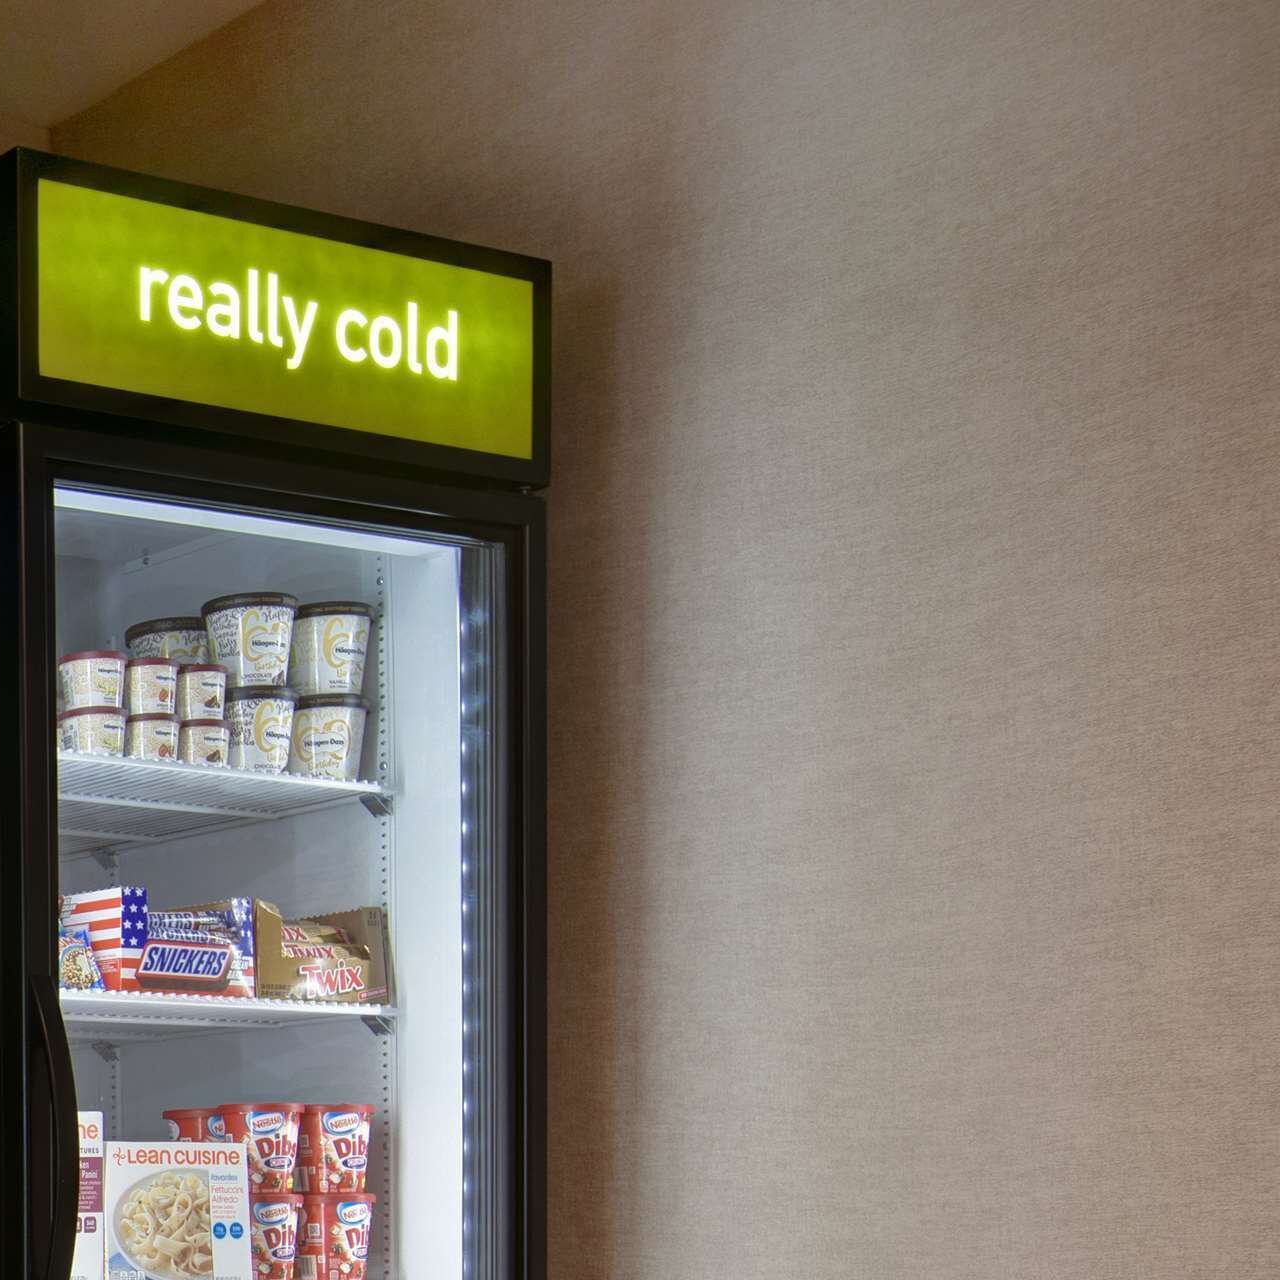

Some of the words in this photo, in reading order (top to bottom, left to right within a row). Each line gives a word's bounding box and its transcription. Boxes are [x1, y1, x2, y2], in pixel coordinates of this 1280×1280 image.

[138, 264, 319, 370] really
[334, 302, 460, 380] cold
[142, 946, 229, 976] SNICKERS
[127, 1149, 171, 1165] Lean
[174, 1149, 240, 1165] cuisine
